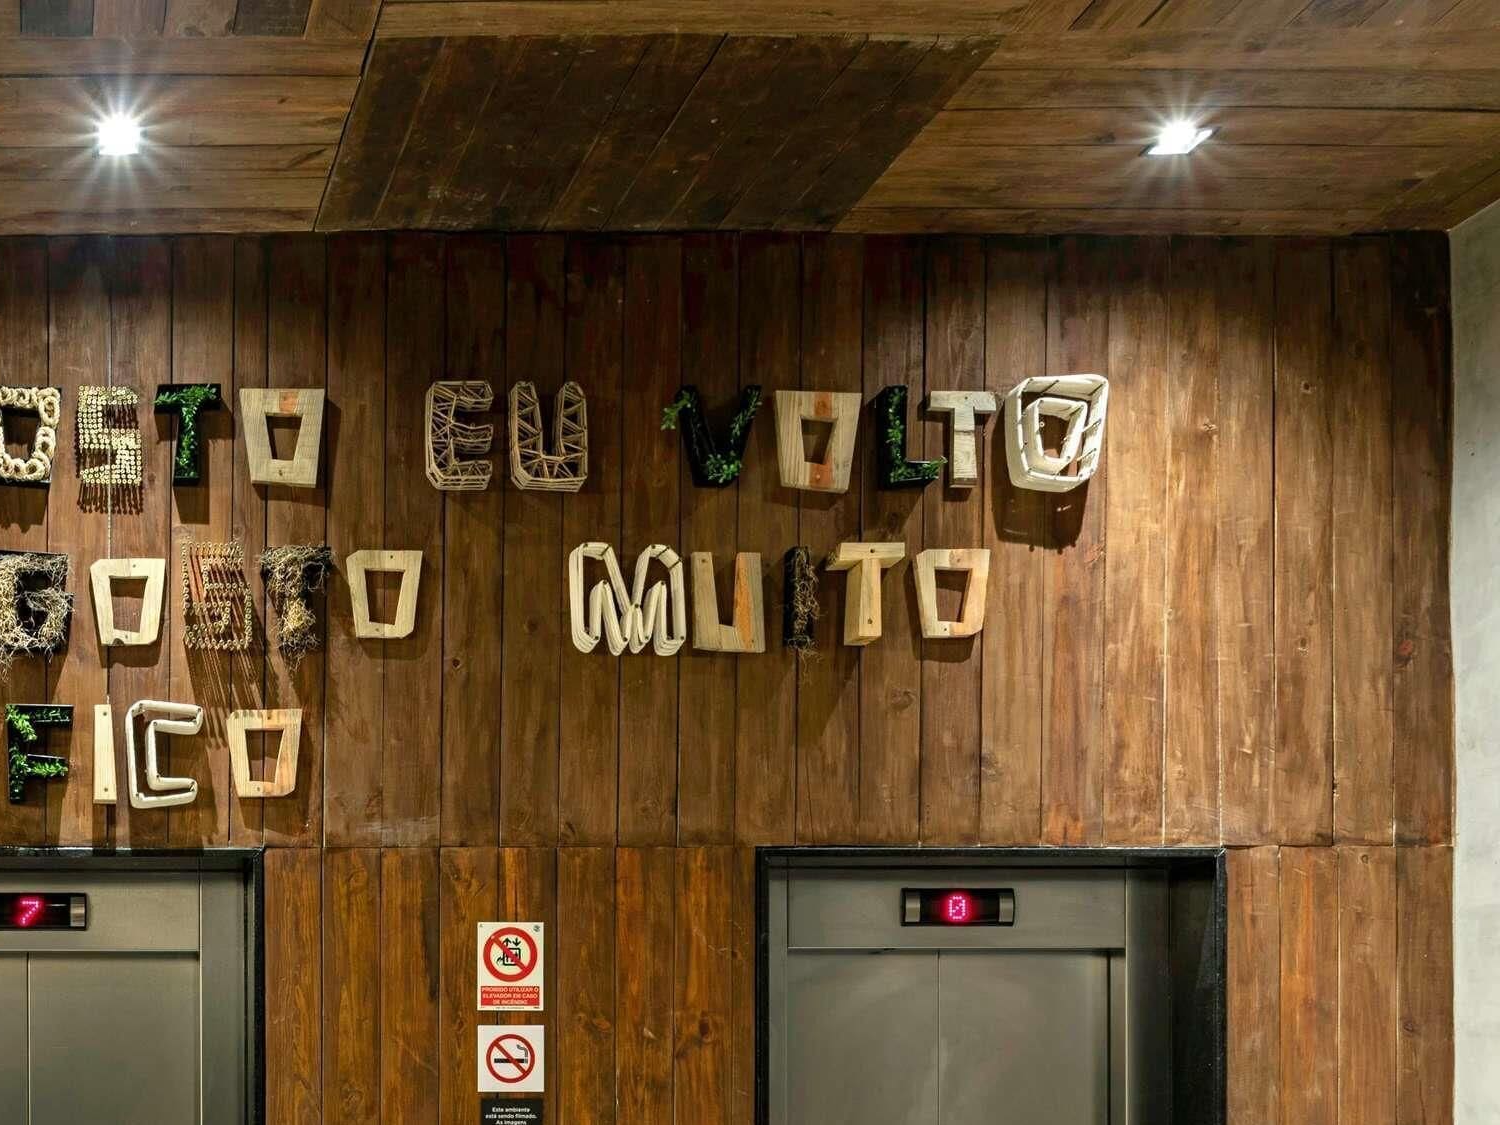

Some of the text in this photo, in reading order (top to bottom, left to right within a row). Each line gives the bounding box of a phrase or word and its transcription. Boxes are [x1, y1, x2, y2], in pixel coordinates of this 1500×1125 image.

[425, 380, 588, 492] EU
[661, 374, 1109, 493] VOLTO
[569, 541, 991, 656] MUITO
[6, 699, 303, 809] FICO
[21, 900, 39, 924] 7
[948, 895, 966, 920] 0
